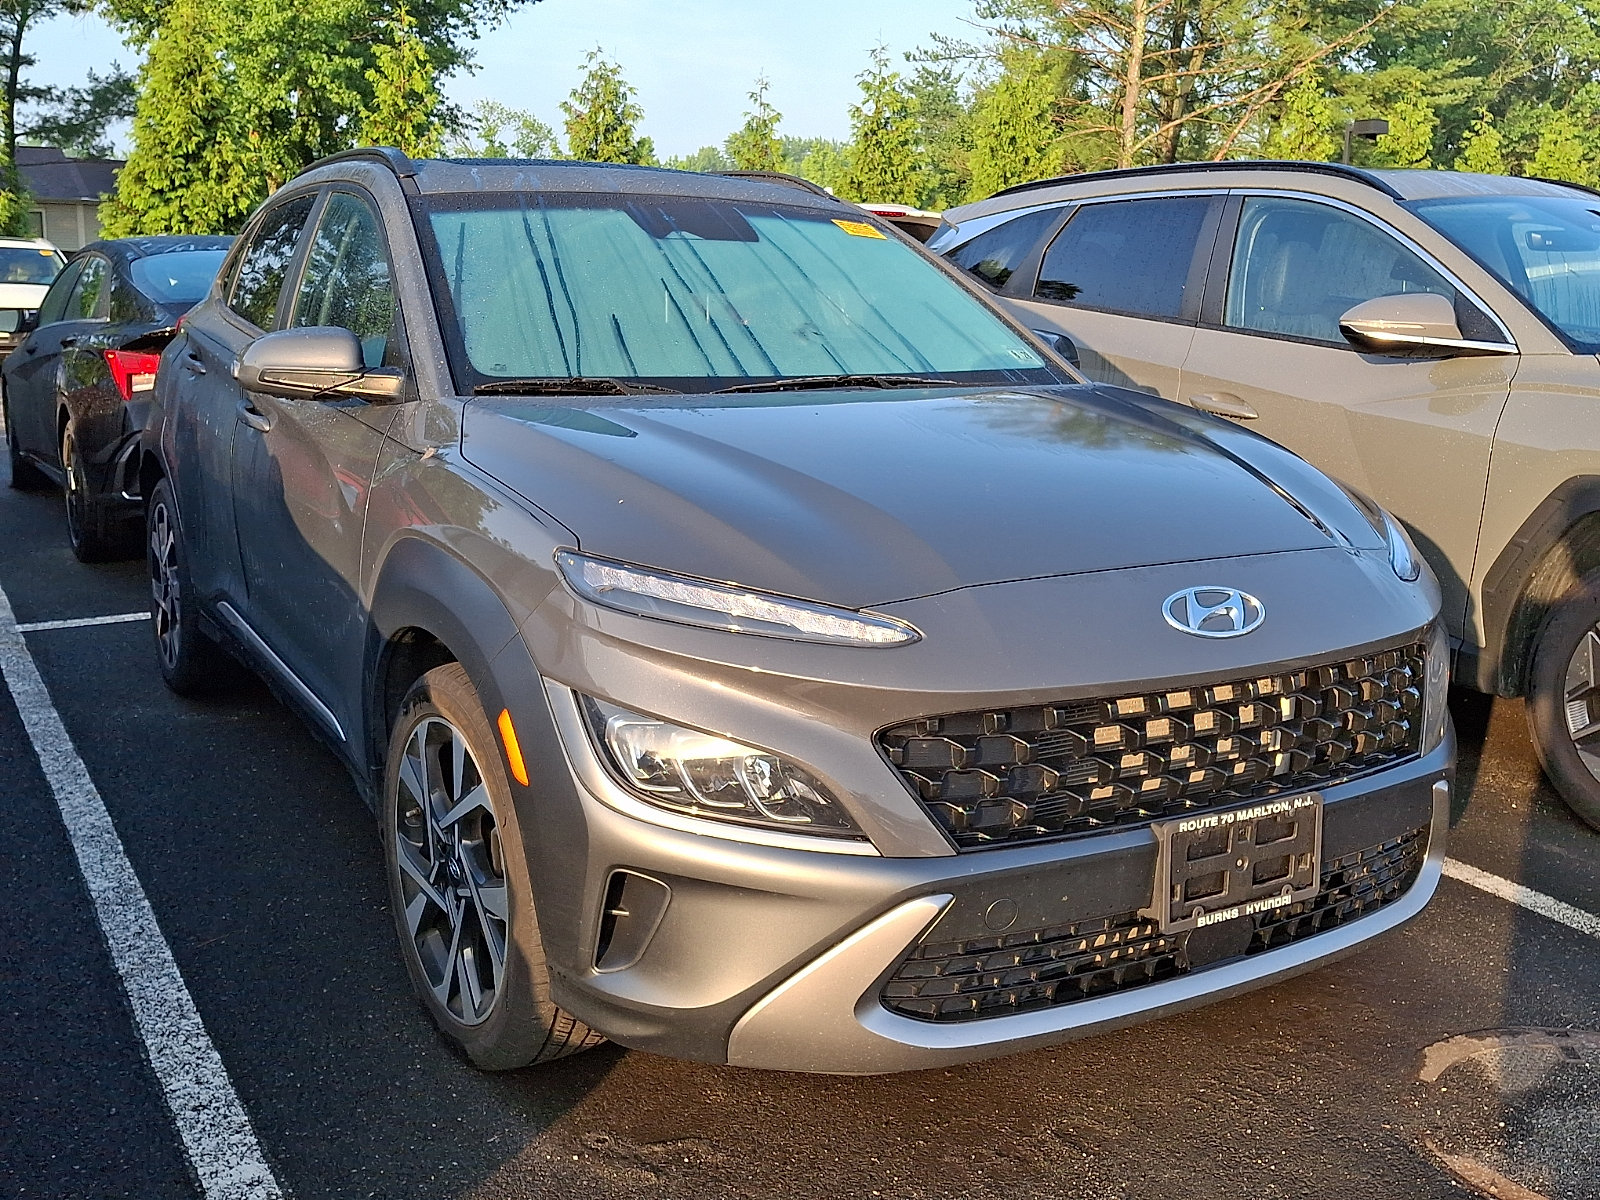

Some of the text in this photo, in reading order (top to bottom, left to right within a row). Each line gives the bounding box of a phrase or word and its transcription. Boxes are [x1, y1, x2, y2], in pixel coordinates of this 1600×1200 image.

[1179, 796, 1314, 833] ROUTE 70 MARLTON, N.J.
[1197, 895, 1292, 928] BURNS HYUNDAI
